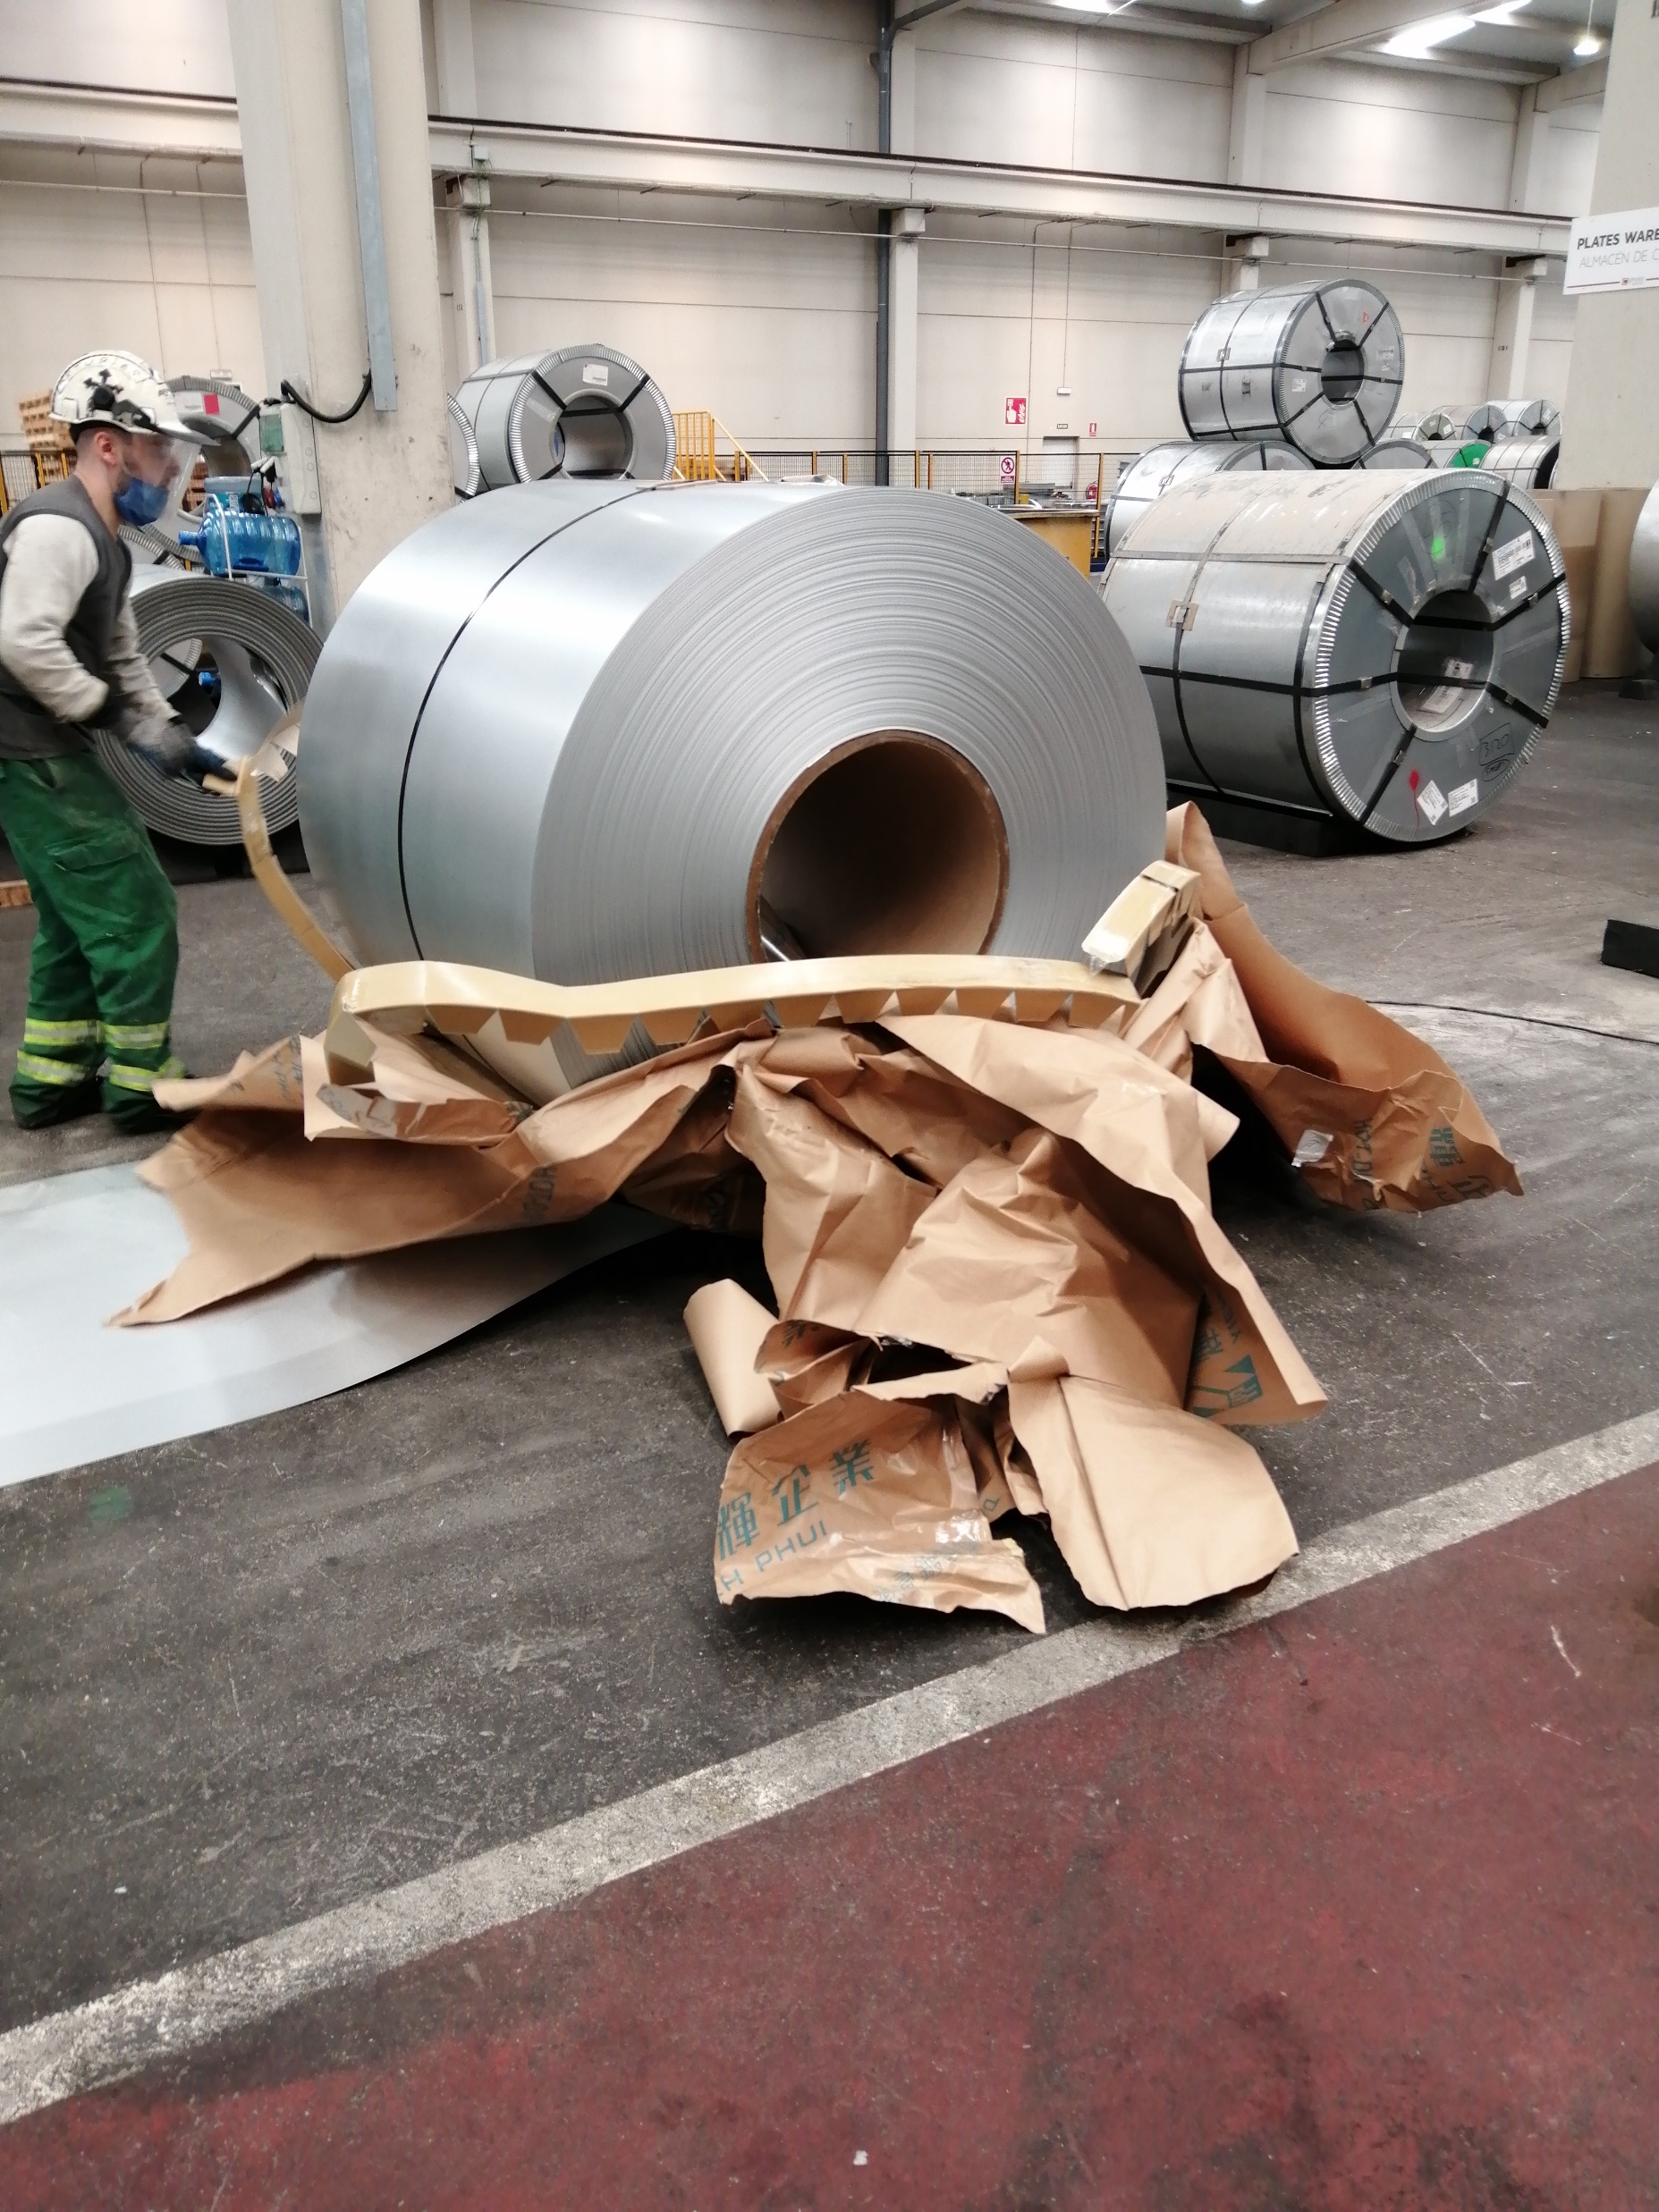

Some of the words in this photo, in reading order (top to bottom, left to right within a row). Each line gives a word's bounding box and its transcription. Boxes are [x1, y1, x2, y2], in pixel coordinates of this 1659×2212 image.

[1577, 233, 1621, 250] PLATES
[1579, 252, 1629, 268] ALMACEN
[1633, 249, 1648, 263] DE
[755, 1520, 827, 1573] PHUI
